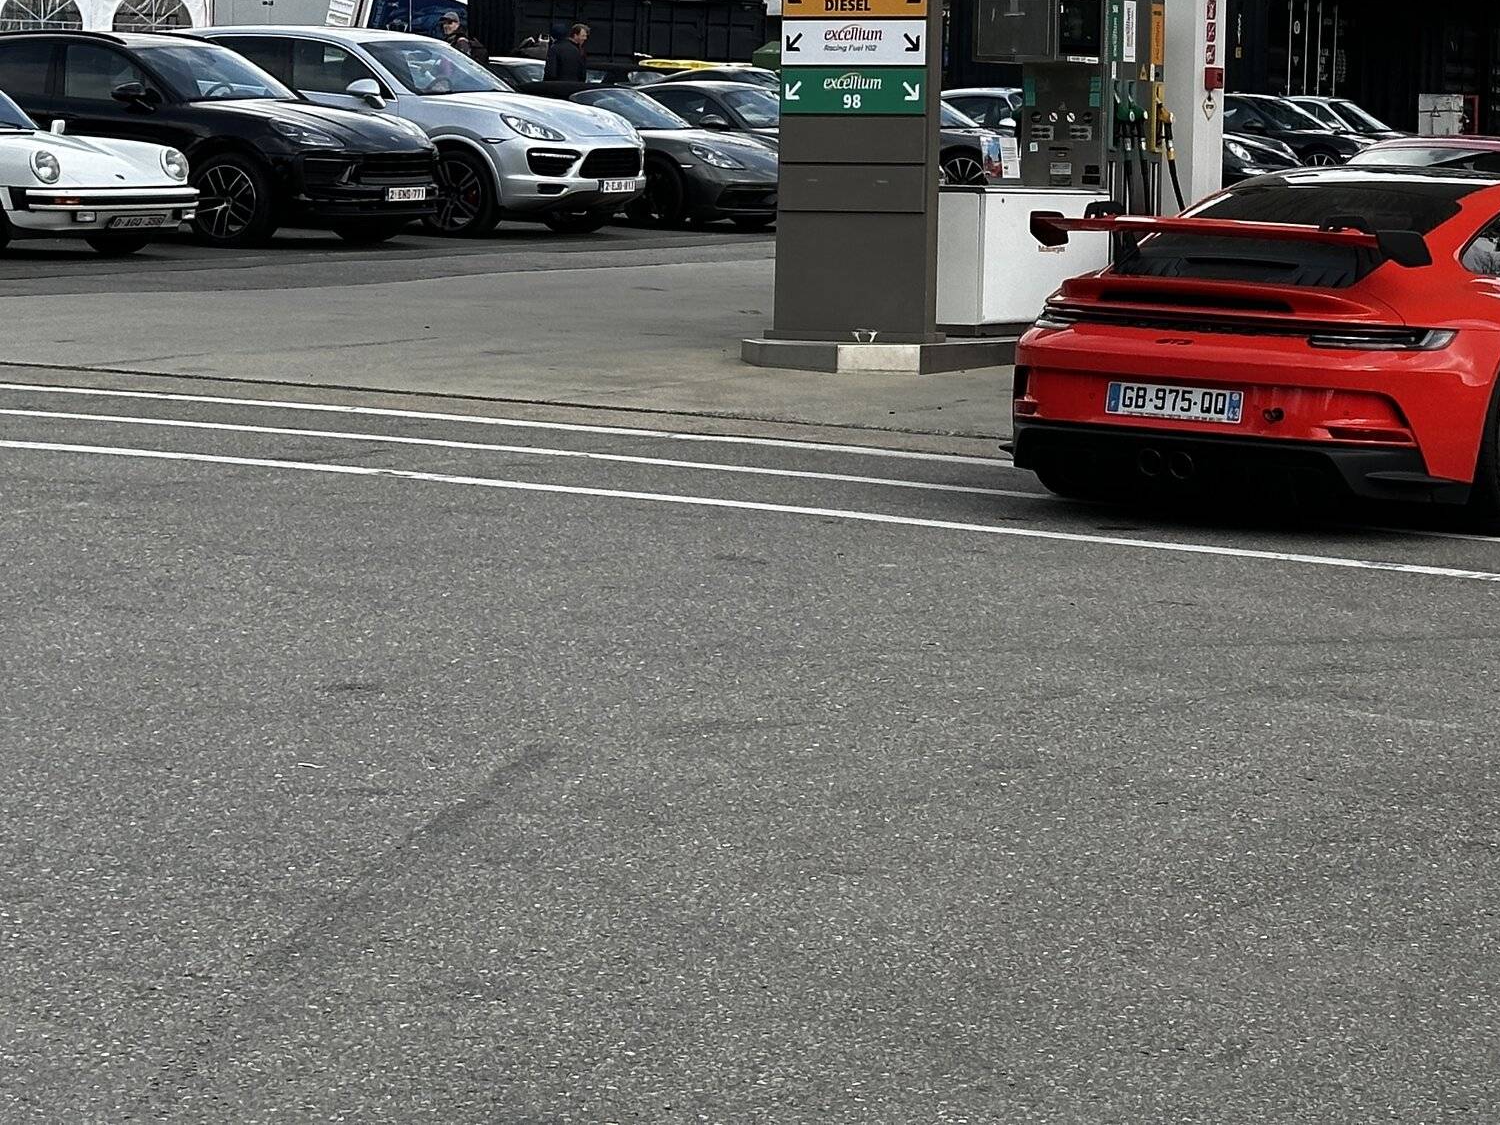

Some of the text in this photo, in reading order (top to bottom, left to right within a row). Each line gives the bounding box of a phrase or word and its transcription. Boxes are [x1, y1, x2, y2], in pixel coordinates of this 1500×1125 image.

[824, 26, 883, 41] excellium
[823, 74, 882, 90] excellium
[842, 93, 862, 109] 98
[1121, 385, 1227, 416] GB-975-QQ
